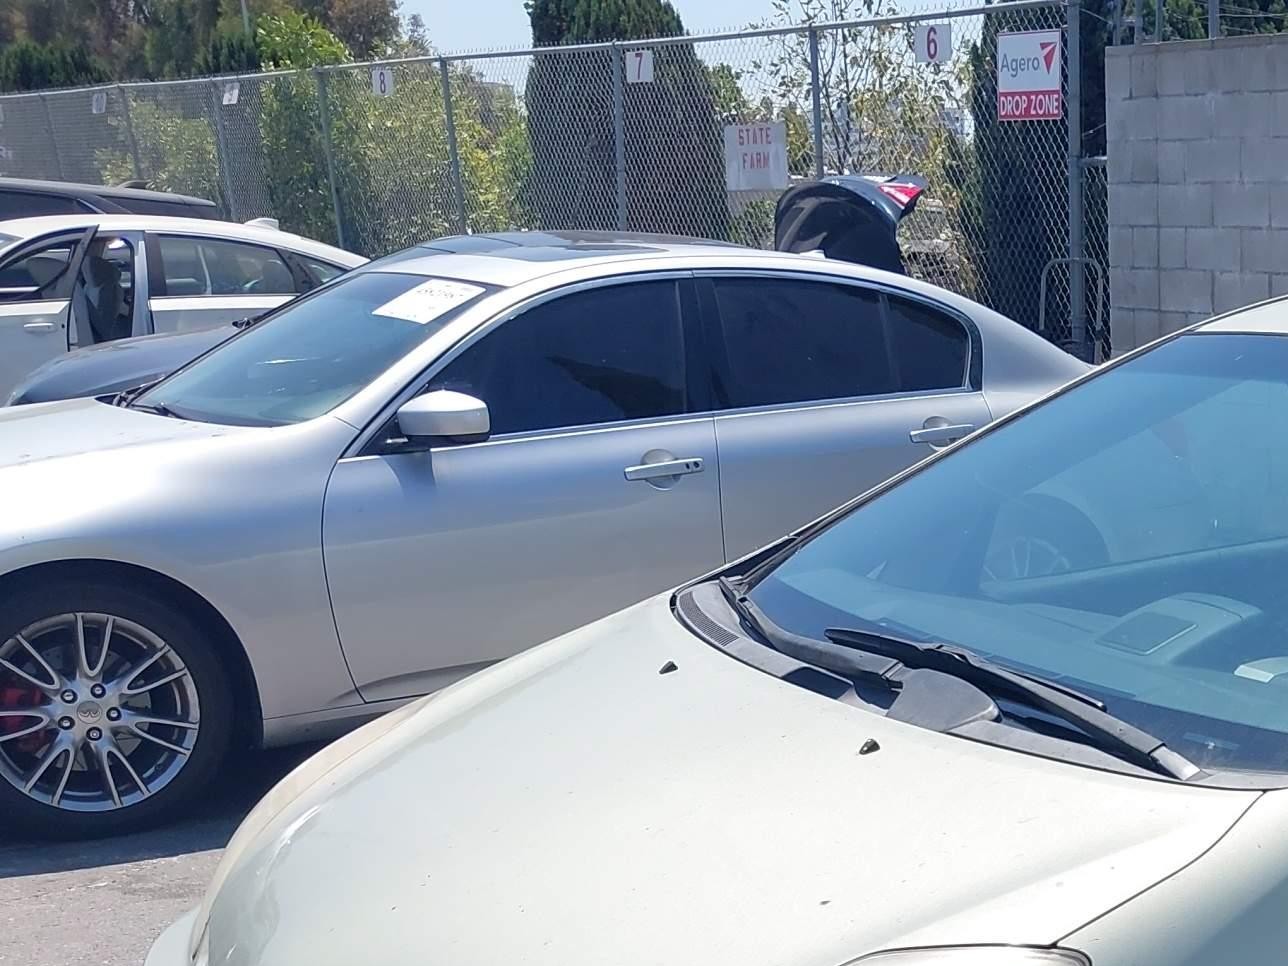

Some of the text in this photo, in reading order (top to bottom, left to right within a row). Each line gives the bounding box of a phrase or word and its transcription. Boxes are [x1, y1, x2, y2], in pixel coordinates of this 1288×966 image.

[926, 26, 938, 60] 6
[634, 52, 644, 81] 7
[1000, 53, 1040, 78] Agero
[378, 71, 387, 94] 8
[1000, 94, 1059, 116] DROP ZONE
[738, 127, 772, 146] STATE
[742, 151, 770, 169] FARM
